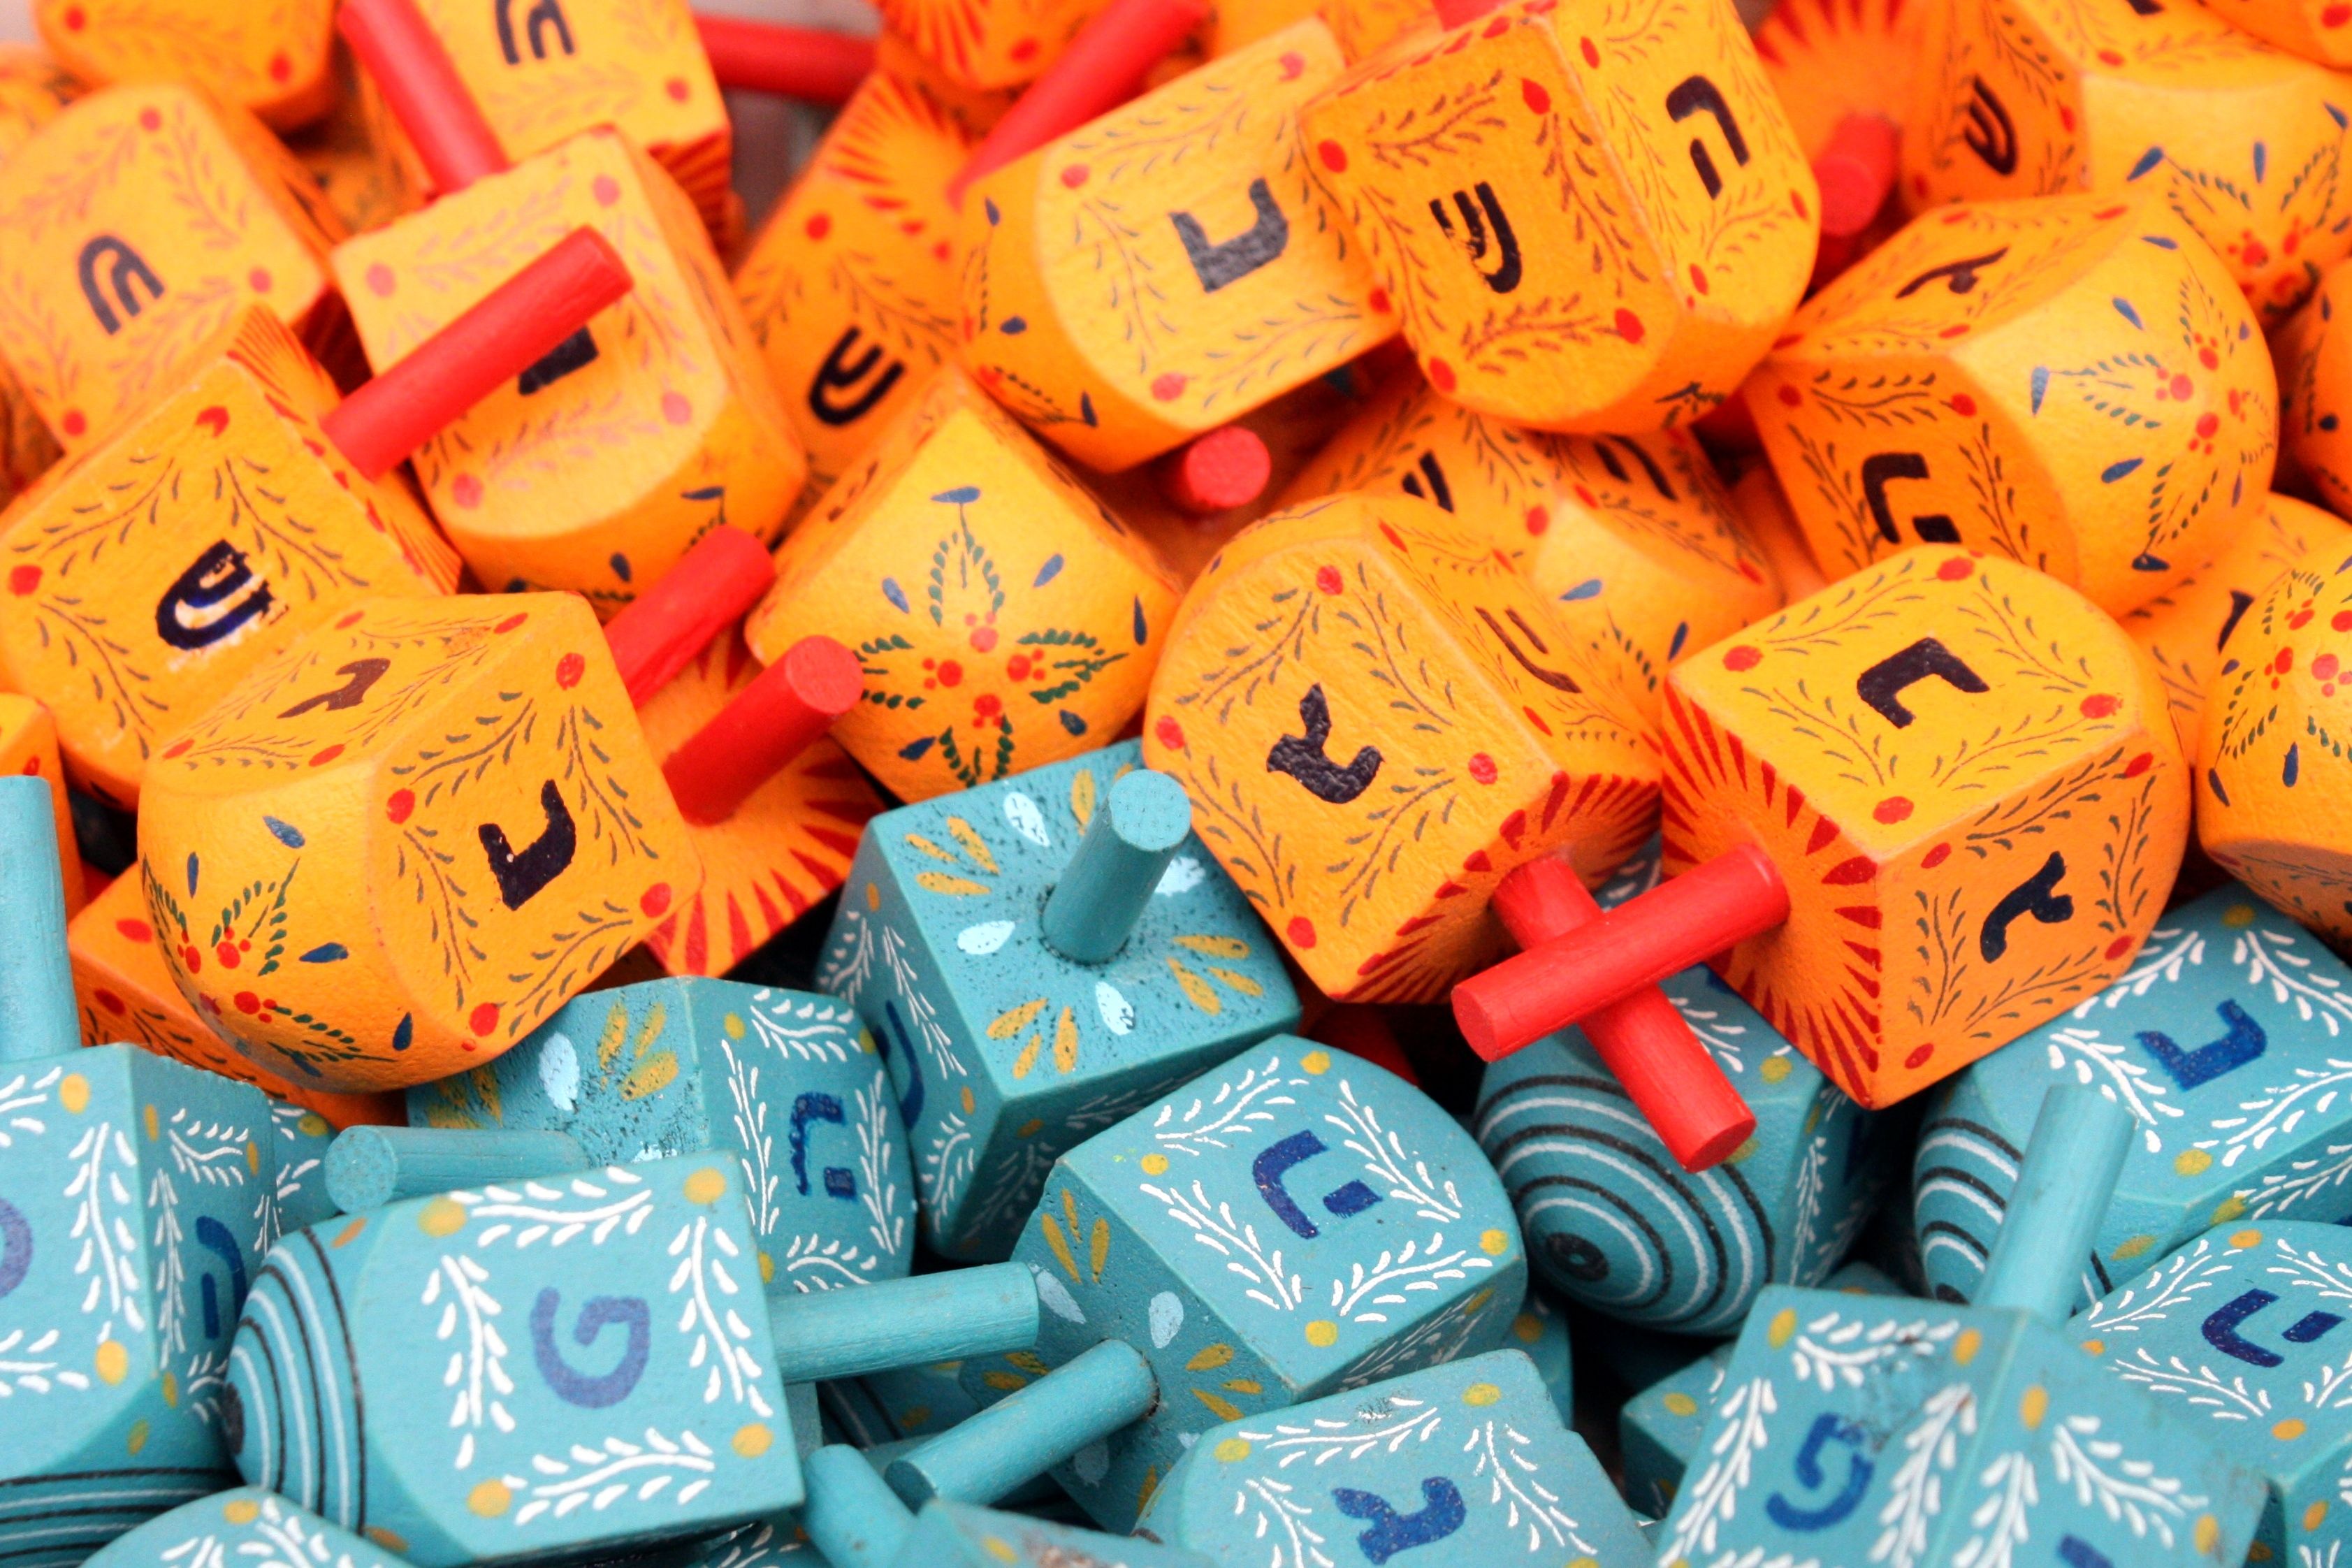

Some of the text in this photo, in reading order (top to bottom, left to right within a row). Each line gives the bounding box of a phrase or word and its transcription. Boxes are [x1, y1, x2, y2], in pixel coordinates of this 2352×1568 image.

[1667, 76, 1750, 200] ה
[1962, 75, 2019, 177] ש
[79, 235, 164, 335] ש
[1170, 178, 1289, 294] נ
[1430, 183, 1523, 294] ש
[808, 327, 906, 428] ש
[1862, 453, 1962, 544] ה
[156, 539, 275, 652] ש
[277, 658, 391, 719] ג
[1857, 637, 1991, 729] נ
[1266, 683, 1385, 804] ג
[479, 779, 576, 910] נ
[1980, 851, 2075, 964] ג
[2134, 999, 2268, 1091] נ
[789, 1091, 859, 1201] ה
[1251, 1129, 1384, 1240] ה
[196, 1216, 248, 1340] ה
[2200, 1288, 2346, 1368] ה
[529, 1287, 651, 1410] פ
[1331, 1476, 1468, 1566] ג
[1765, 1412, 1875, 1532] פ
